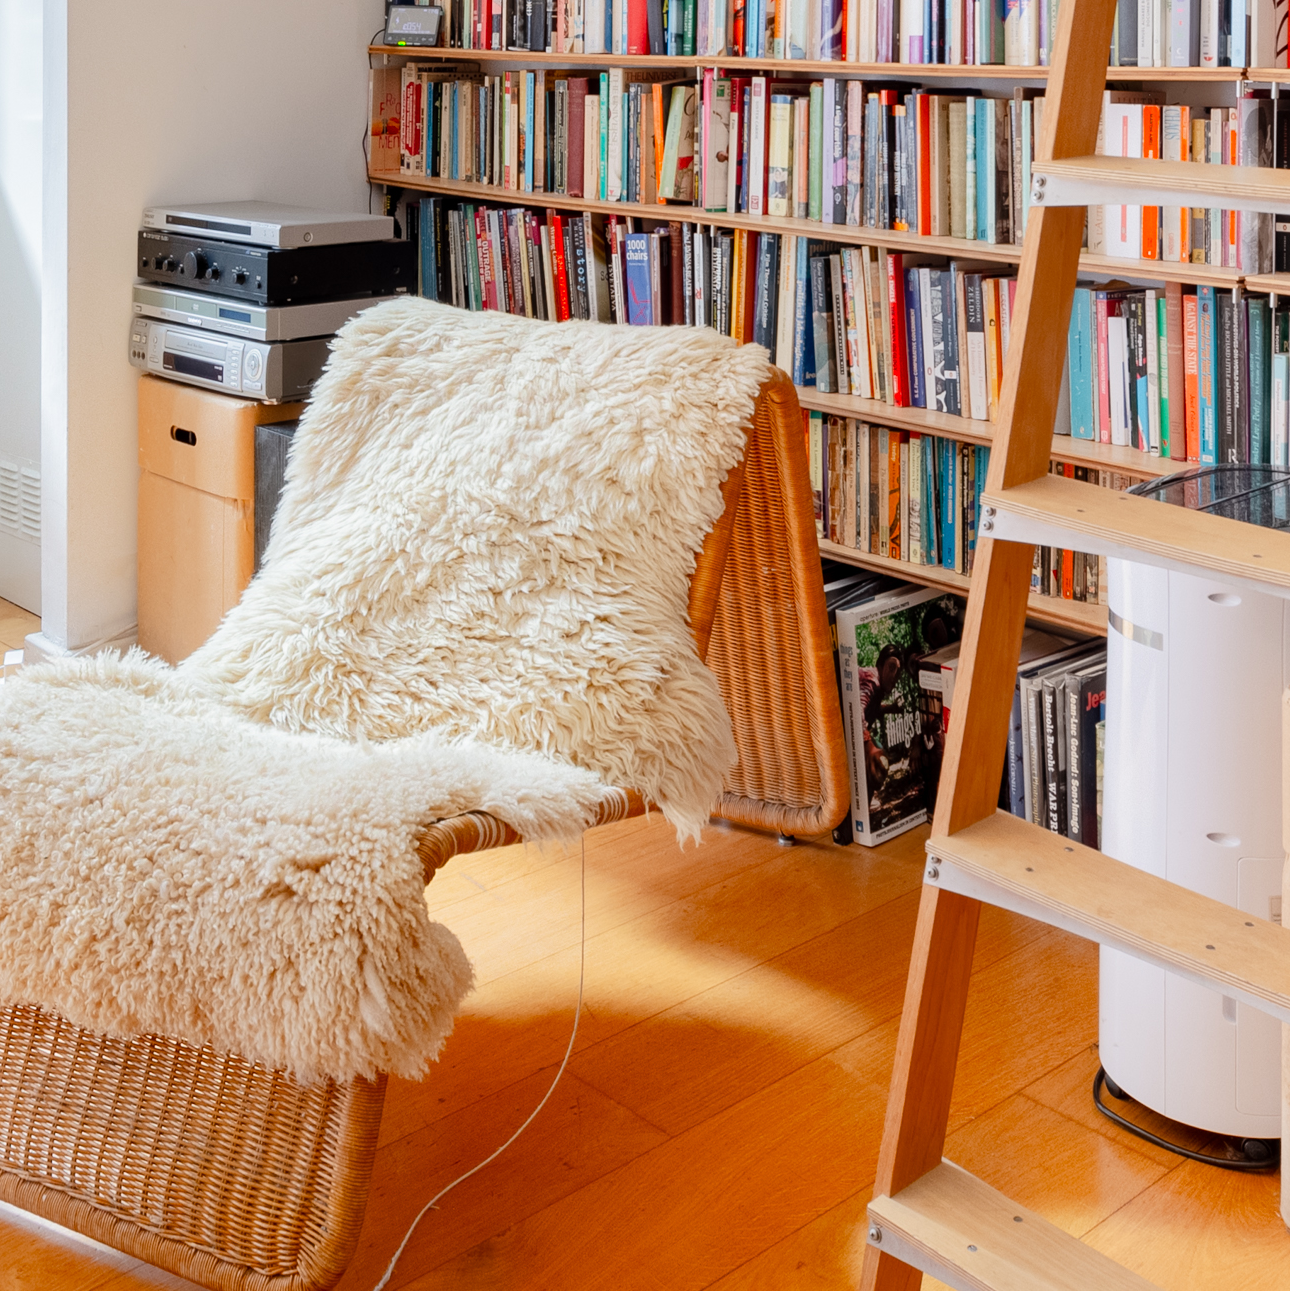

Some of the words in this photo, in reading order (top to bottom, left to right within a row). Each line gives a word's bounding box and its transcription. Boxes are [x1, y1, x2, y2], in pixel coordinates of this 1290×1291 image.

[626, 248, 648, 260] chairs
[627, 239, 646, 250] 1000
[1046, 695, 1054, 735] Bertolt
[1046, 737, 1054, 772] Brecht
[1071, 779, 1080, 834] Son+Image
